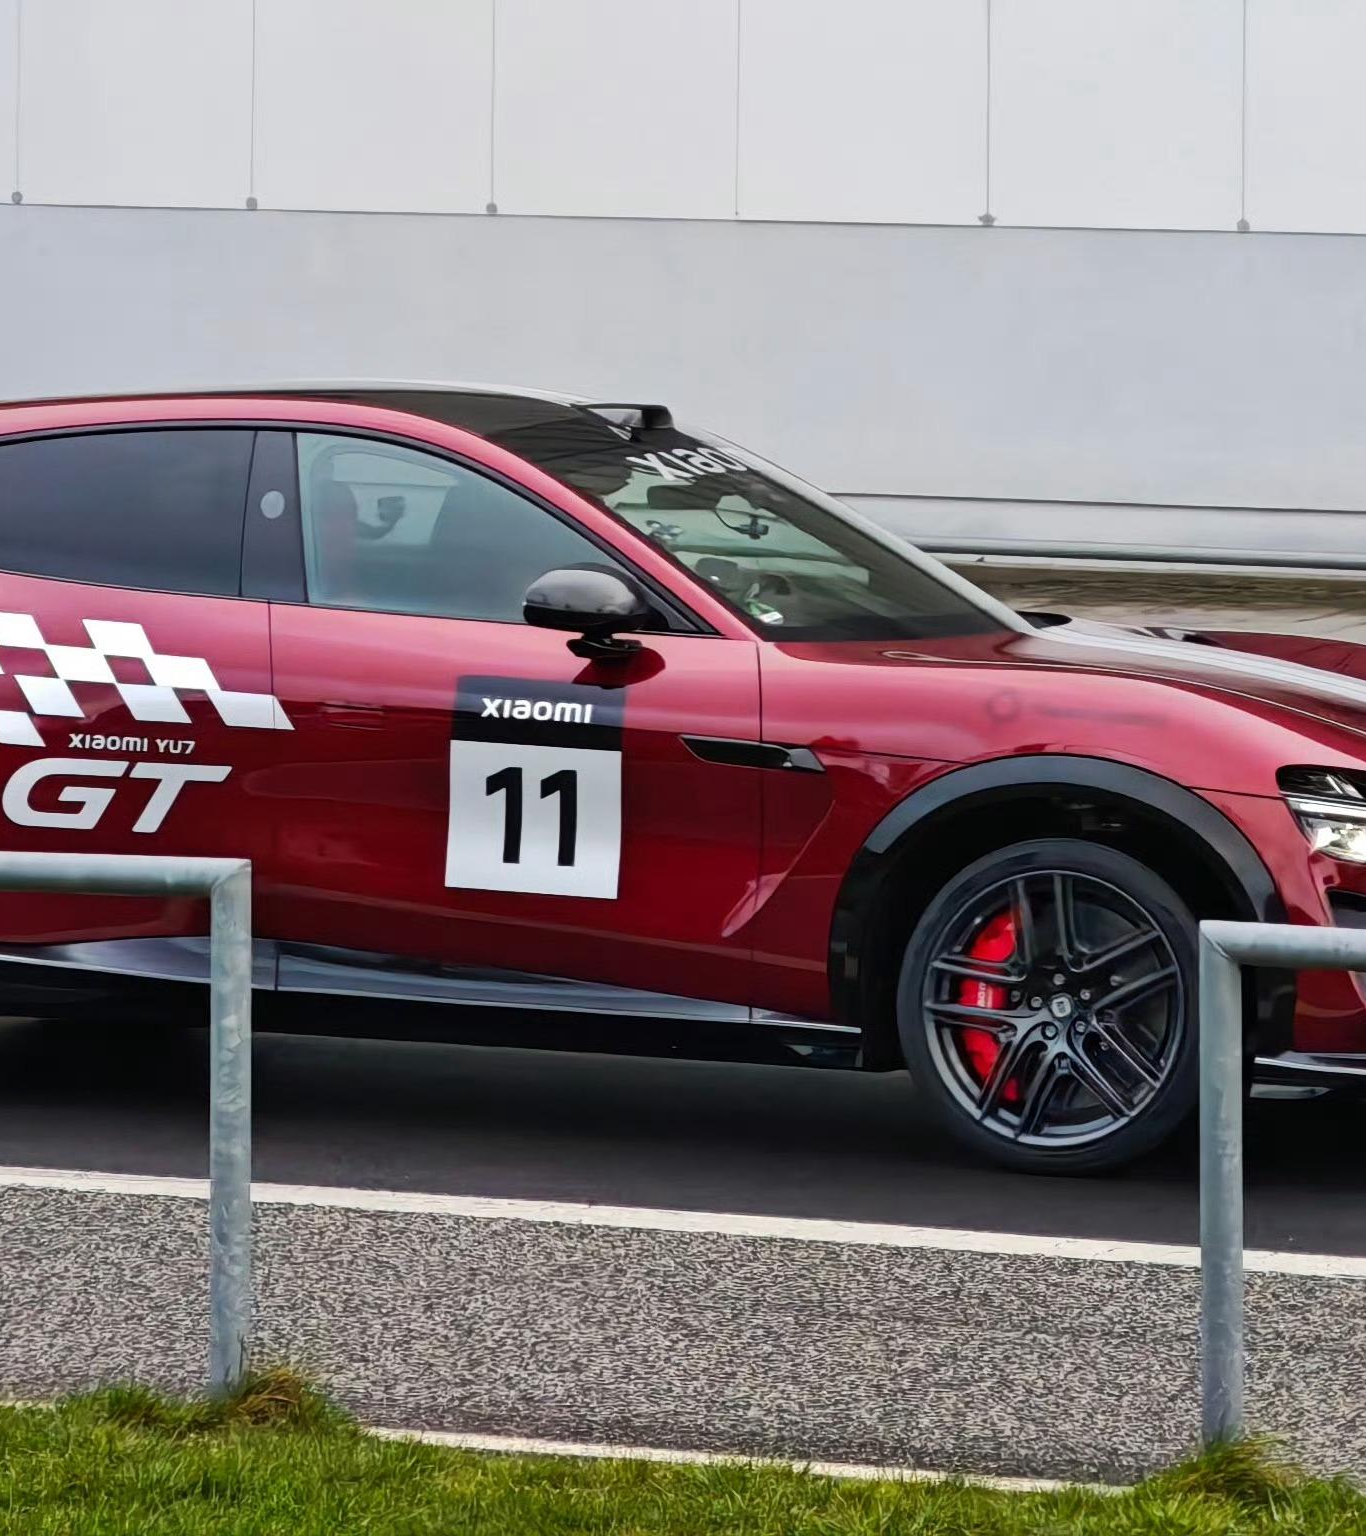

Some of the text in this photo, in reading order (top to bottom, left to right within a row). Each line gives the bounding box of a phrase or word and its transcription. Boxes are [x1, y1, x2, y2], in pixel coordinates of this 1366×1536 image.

[155, 738, 196, 756] YU7
[1, 757, 233, 833] GT
[485, 766, 579, 867] 11
